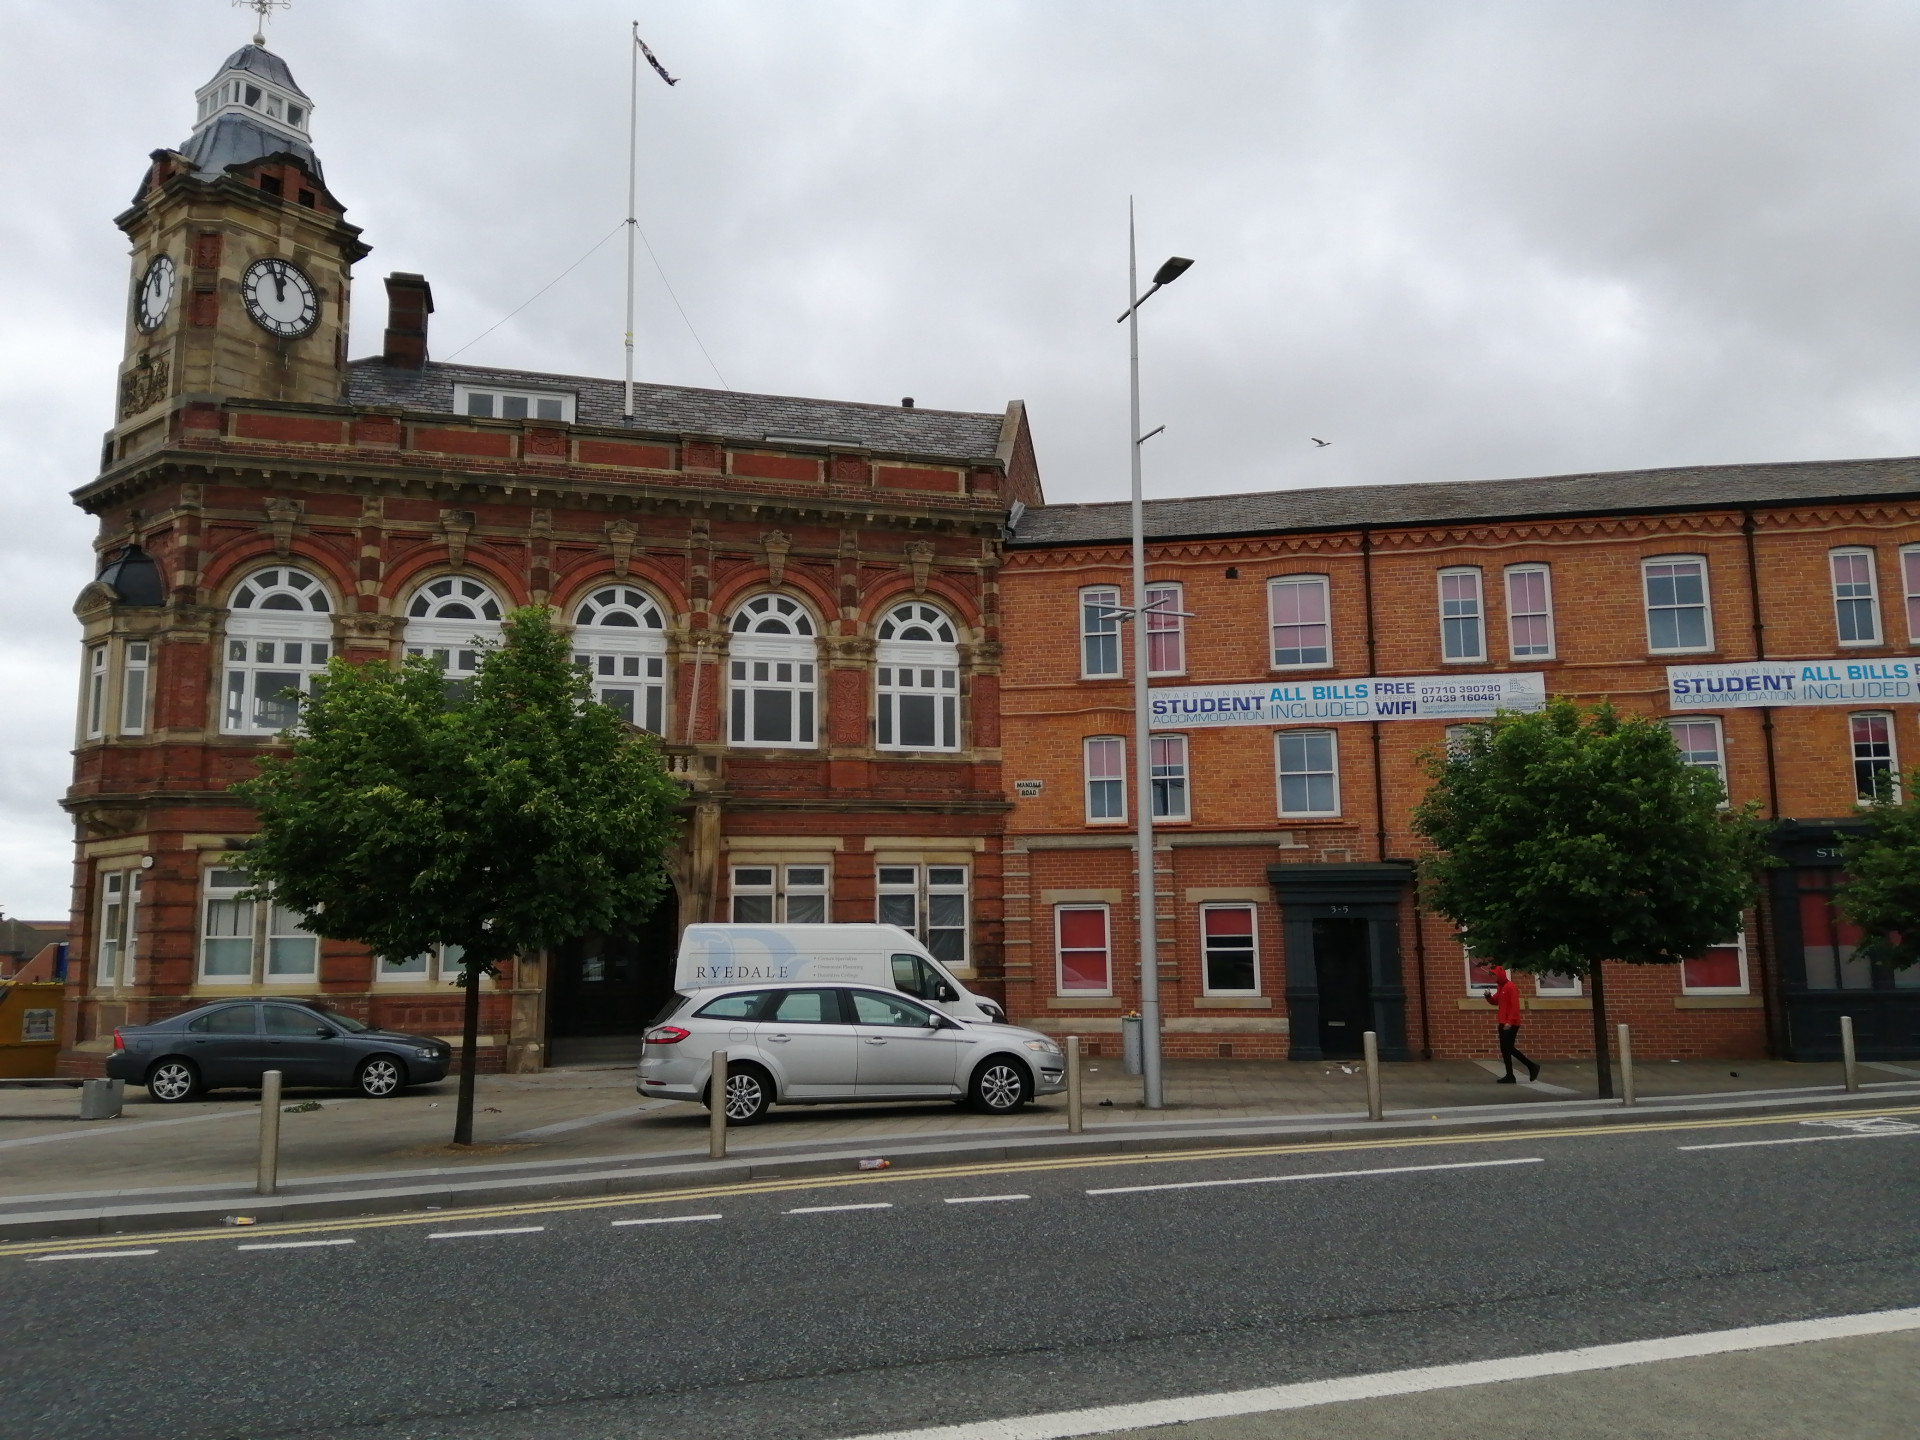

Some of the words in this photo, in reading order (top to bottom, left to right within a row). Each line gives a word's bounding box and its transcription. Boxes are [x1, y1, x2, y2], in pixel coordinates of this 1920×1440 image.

[1672, 669, 1724, 678] AWARD
[1729, 666, 1796, 676] WINNING
[1801, 666, 1841, 681] ALL
[1847, 664, 1909, 680] BILLS
[1374, 682, 1416, 695] FREE
[1421, 686, 1456, 695] 07710
[1459, 684, 1501, 693] 390790
[1673, 674, 1796, 694] STUDENT
[1803, 681, 1911, 700] INCLUDED
[1152, 691, 1199, 700] AWARD
[1204, 689, 1265, 698] WINNING
[1269, 687, 1306, 702] ALL
[1312, 684, 1369, 700] BILLS
[1422, 694, 1457, 704] 07439
[1459, 693, 1501, 702] 160461
[1674, 691, 1797, 704] ACCOMMODATION
[1152, 695, 1266, 714] STUDENT
[1270, 700, 1370, 719] INCLUDED
[1376, 701, 1417, 715] WIFI
[1153, 711, 1266, 725] ACCOMMODATION
[696, 965, 789, 979] RYEDALE
